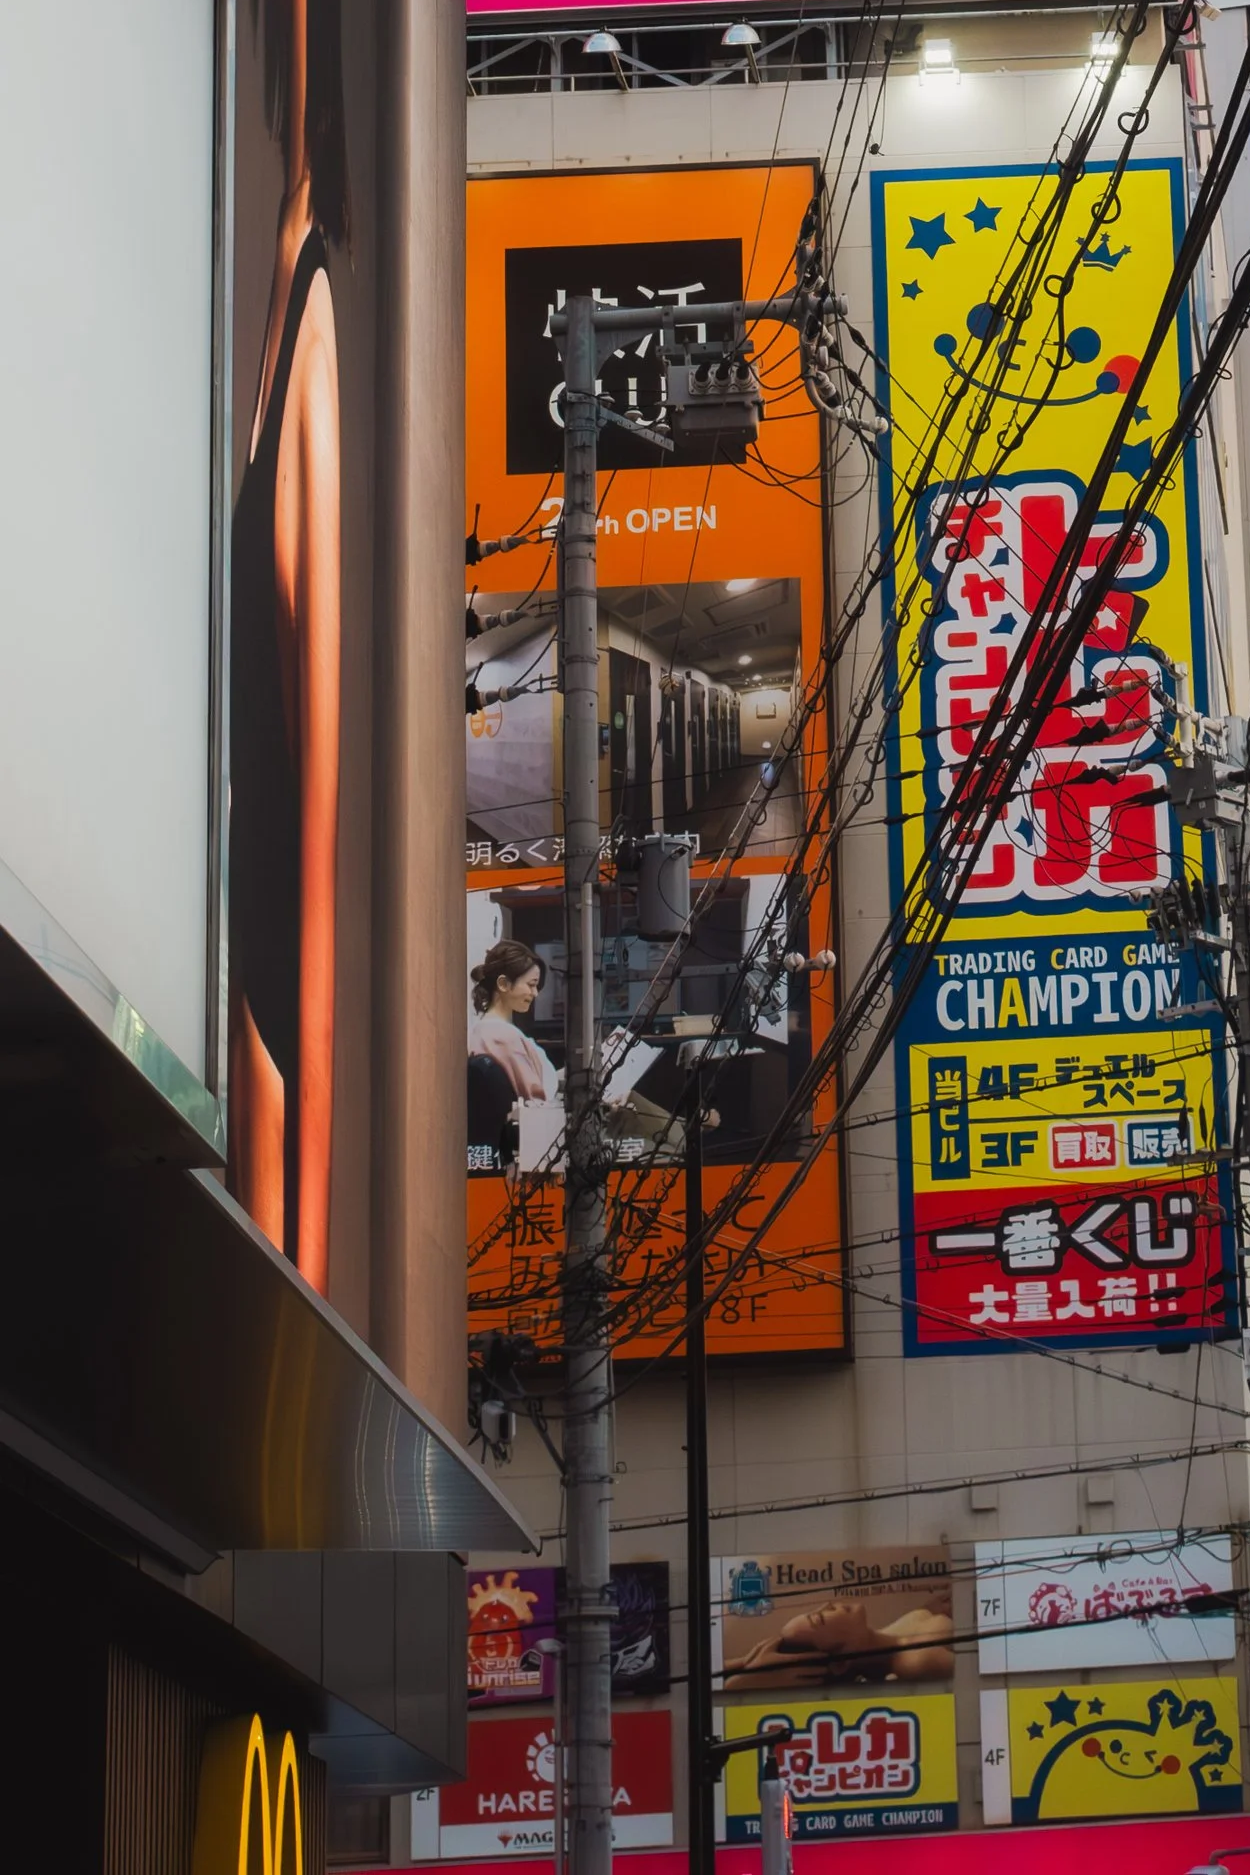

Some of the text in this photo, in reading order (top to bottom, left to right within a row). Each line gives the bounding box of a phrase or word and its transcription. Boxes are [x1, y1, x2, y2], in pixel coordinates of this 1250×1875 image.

[626, 505, 718, 535] OPEN
[934, 942, 1181, 976] TRADING CARD GAME
[936, 968, 1181, 1031] CHAMPION
[977, 1062, 1038, 1101] 4F
[1083, 1078, 1187, 1108] スペース
[935, 1068, 962, 1163] 当ビル
[980, 1127, 1189, 1168] 3F 買取 販売
[936, 1197, 1194, 1267] 一番くじ
[777, 1559, 833, 1585] Head
[842, 1560, 882, 1584] Spa
[980, 1598, 1000, 1617] 7F
[984, 1748, 1005, 1766] 4F
[779, 1764, 911, 1793] ャンピオン
[478, 1786, 631, 1815] HAREA
[805, 1815, 837, 1831] CARD
[843, 1812, 874, 1828] GAME
[882, 1809, 944, 1826] CHAMPION
